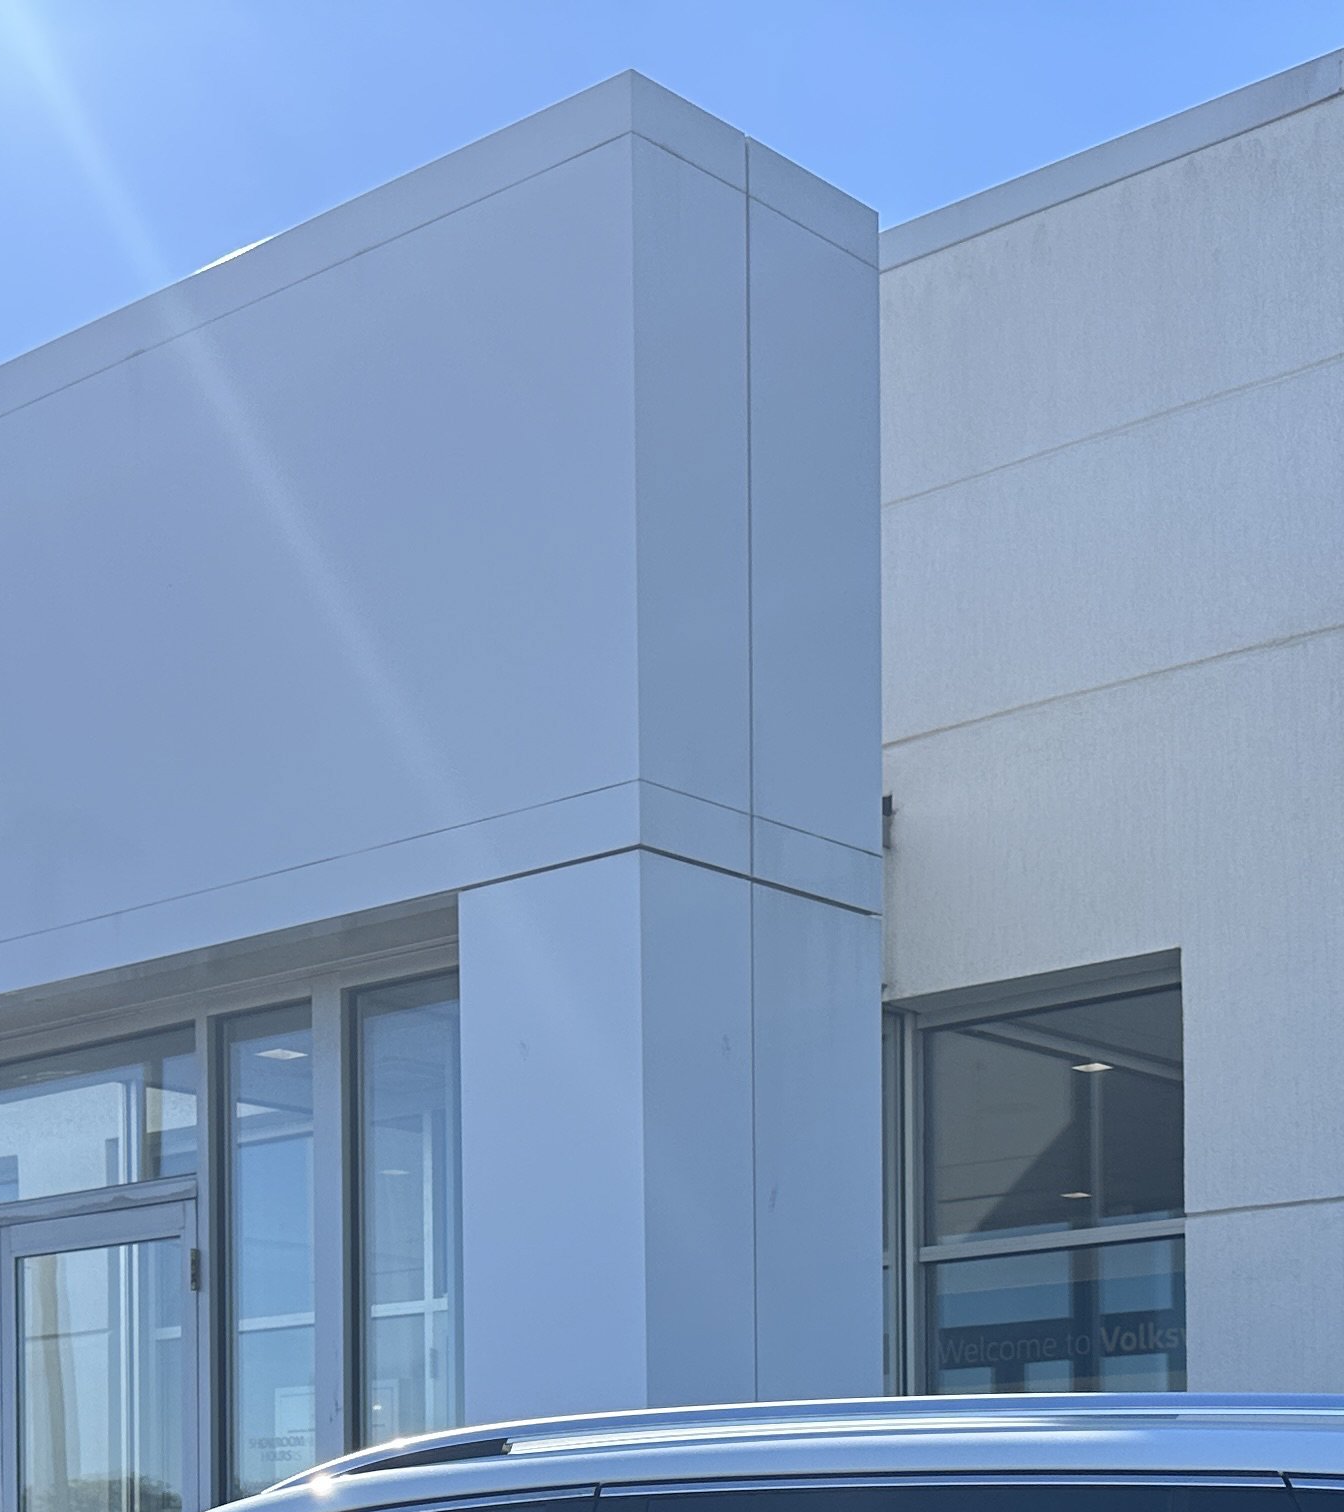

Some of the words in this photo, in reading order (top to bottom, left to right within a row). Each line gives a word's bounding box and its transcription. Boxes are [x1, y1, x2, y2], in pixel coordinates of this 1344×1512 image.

[939, 1336, 1056, 1364] Welcome
[1066, 1332, 1091, 1356] to
[1100, 1321, 1187, 1351] Volks
